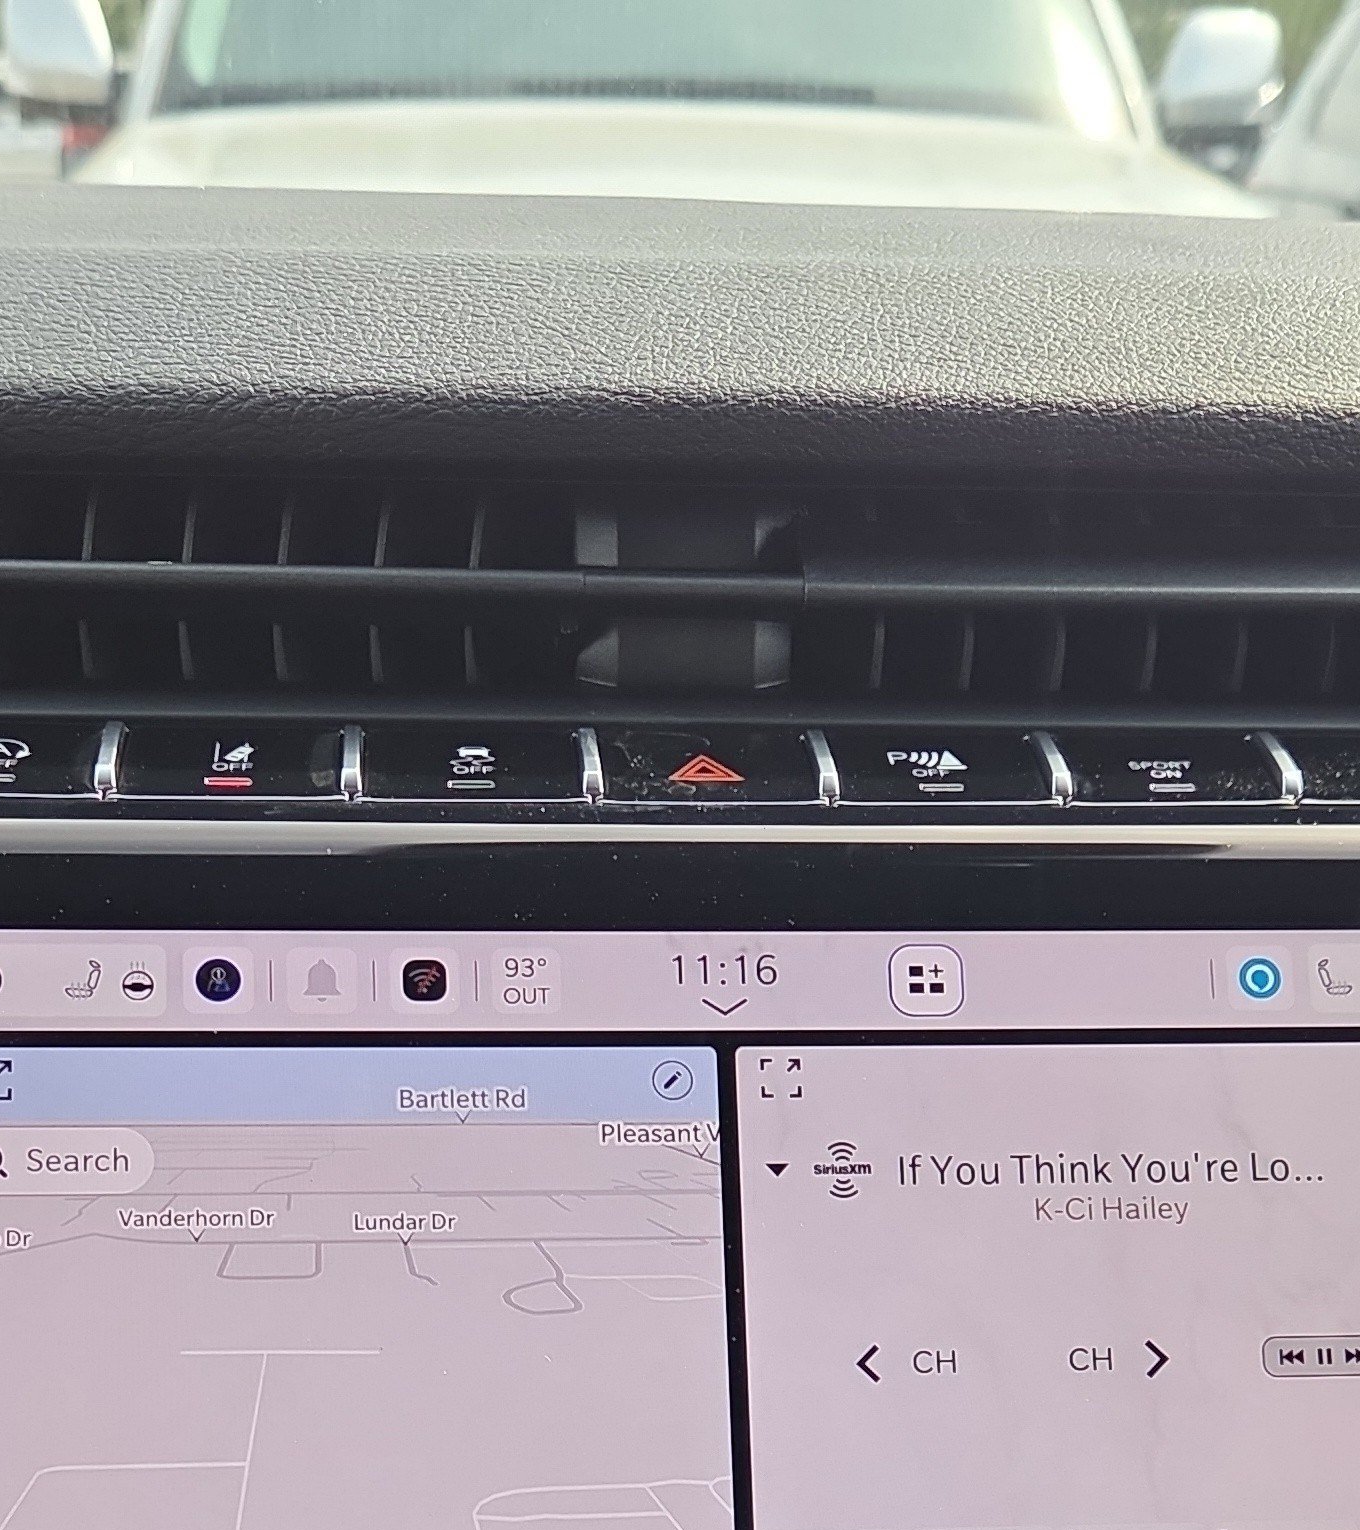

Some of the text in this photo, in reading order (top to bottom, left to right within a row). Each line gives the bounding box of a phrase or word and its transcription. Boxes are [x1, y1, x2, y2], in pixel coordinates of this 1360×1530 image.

[211, 761, 254, 773] OFF
[452, 765, 496, 775] OFF
[911, 767, 950, 778] OFF
[1149, 769, 1183, 779] ON
[504, 957, 547, 979] 93°
[671, 954, 778, 986] 11:16
[503, 986, 551, 1006] OUT
[399, 1088, 526, 1109] Bartlett Rd
[601, 1123, 702, 1143] Pleasant
[25, 1147, 131, 1176] Search
[898, 1151, 1325, 1187] If You Think You're Lo...
[118, 1208, 276, 1228] Vanderhorn Dr
[1033, 1195, 1190, 1225] K-Ci Hailey
[353, 1212, 457, 1232] Lundar Dr
[6, 1229, 32, 1247] Dr
[912, 1350, 958, 1374] CH
[1068, 1348, 1115, 1372] CH
